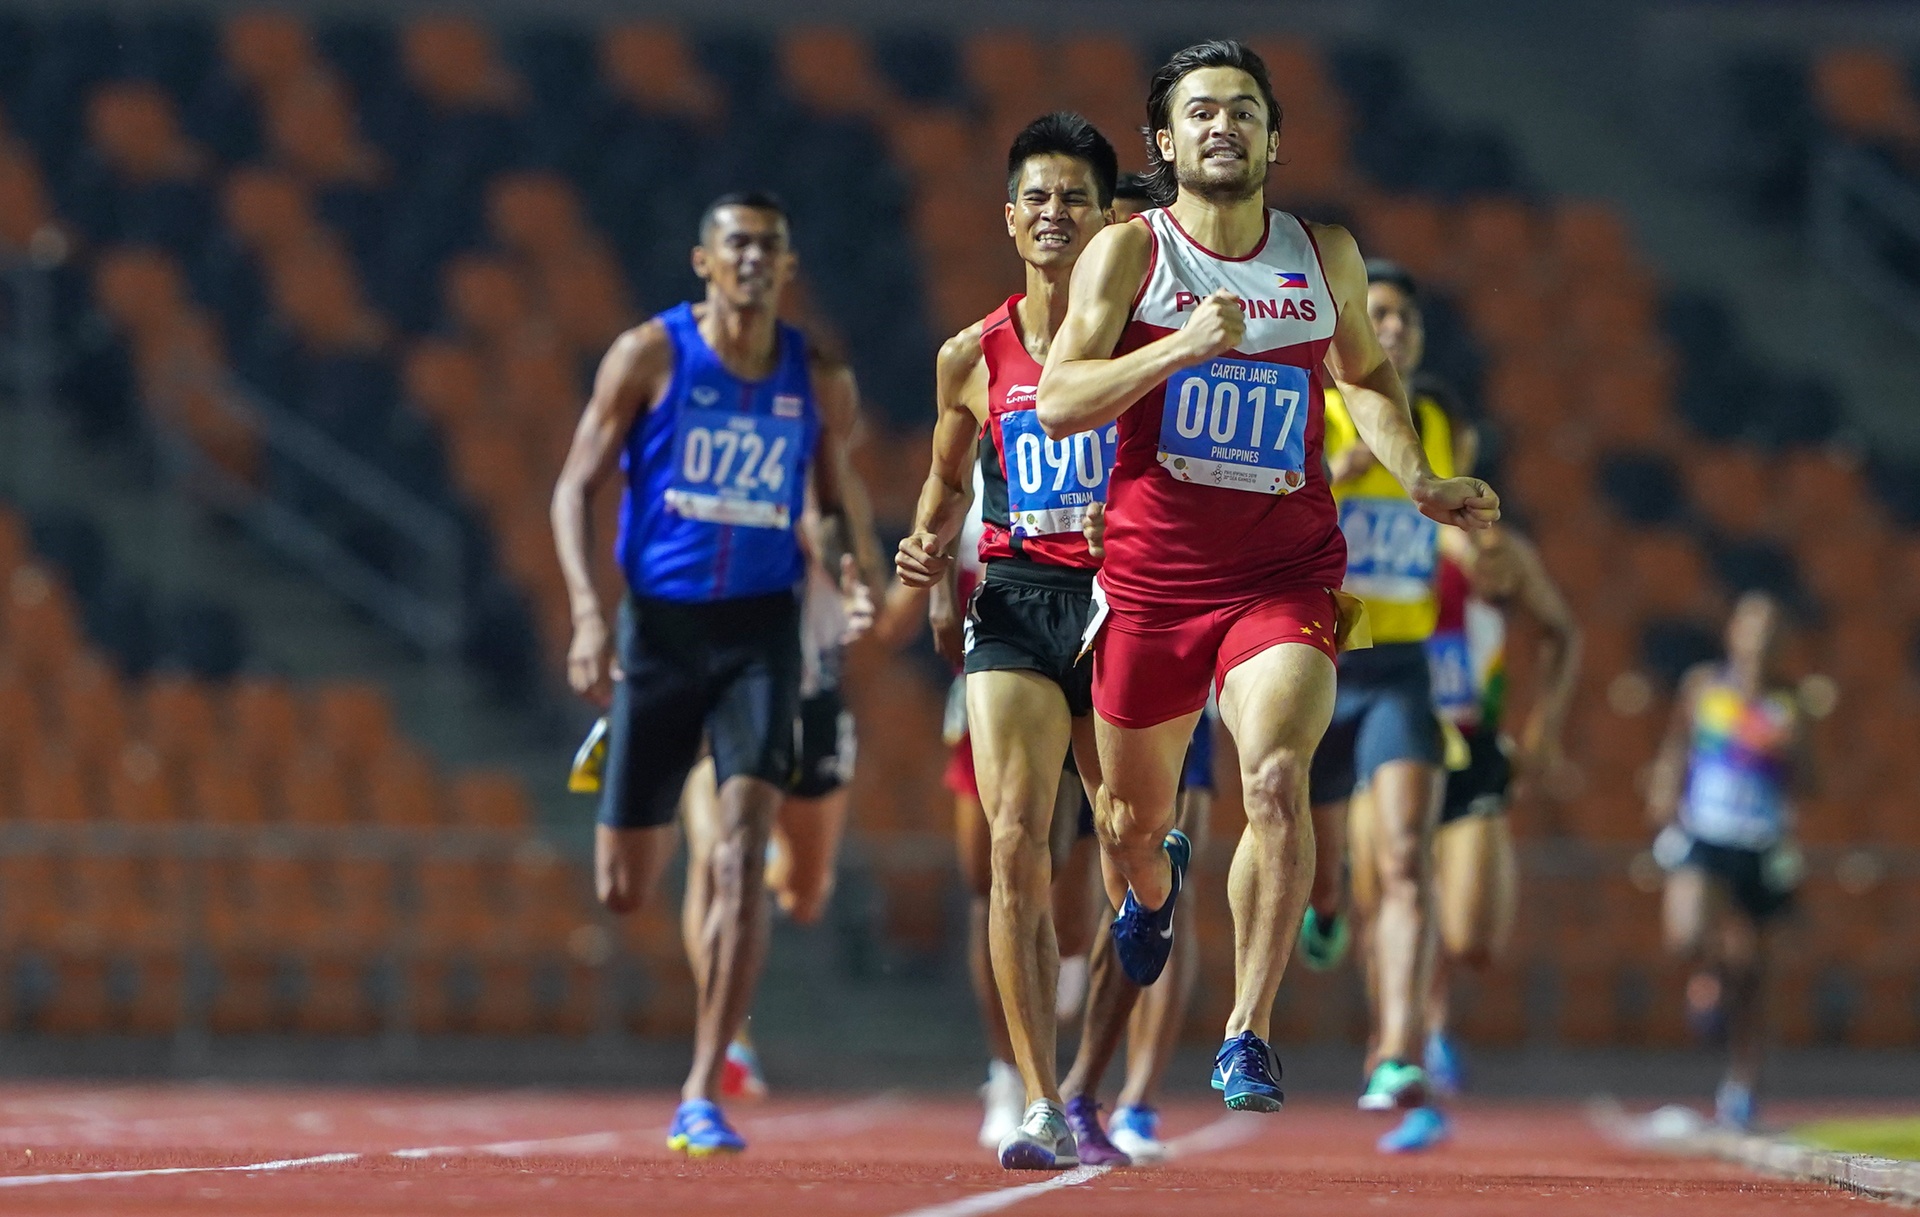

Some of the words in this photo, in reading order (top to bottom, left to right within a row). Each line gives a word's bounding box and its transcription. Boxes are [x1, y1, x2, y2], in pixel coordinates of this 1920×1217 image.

[1175, 291, 1317, 322] PINAS
[1210, 362, 1246, 381] CARTER
[1247, 368, 1278, 385] JAMES
[1176, 377, 1300, 451] 0017
[683, 427, 787, 492] 0724
[1210, 446, 1259, 463] PHILIPPINES
[1060, 491, 1094, 506] VIETNAM
